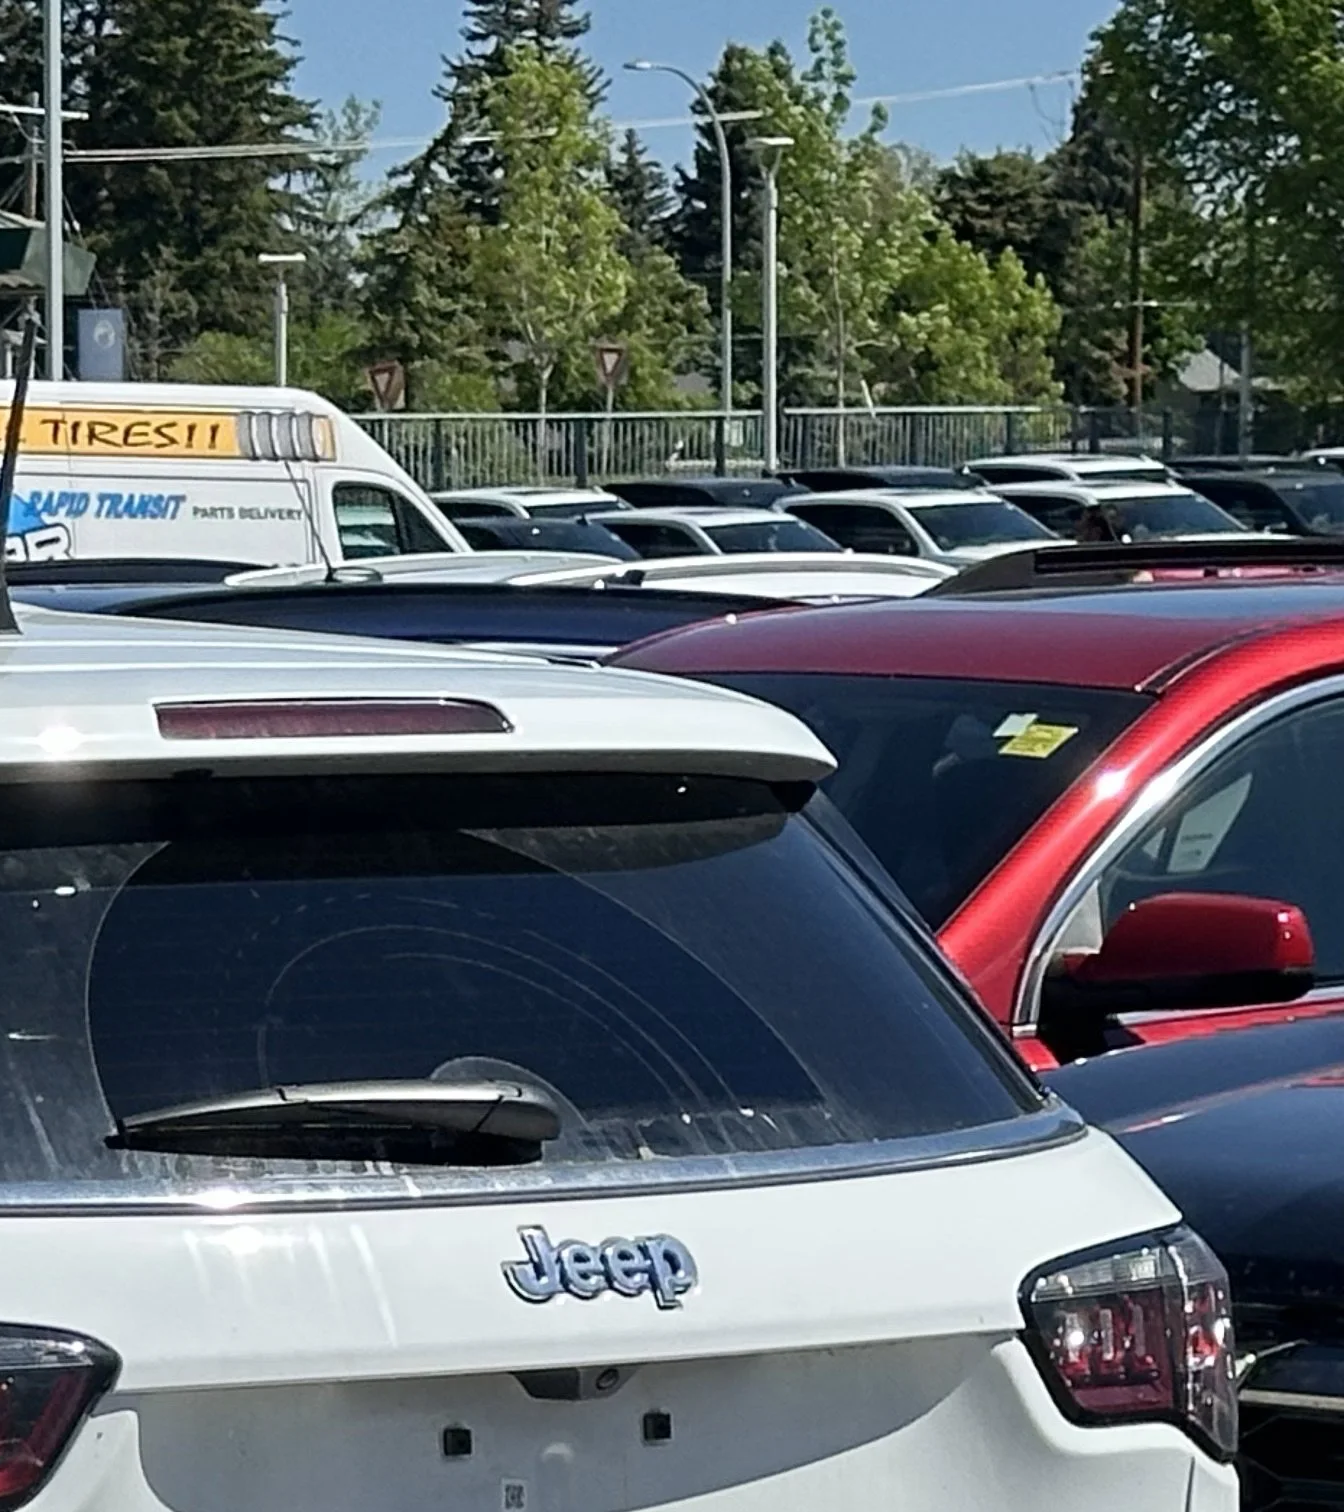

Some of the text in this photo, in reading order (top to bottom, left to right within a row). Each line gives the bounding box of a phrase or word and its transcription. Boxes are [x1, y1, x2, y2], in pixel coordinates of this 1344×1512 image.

[40, 418, 221, 450] TIRES!!
[21, 490, 188, 520] RAPID TRANSIT
[192, 505, 304, 521] PARTS DELIVERY
[500, 1224, 699, 1310] Jeep
